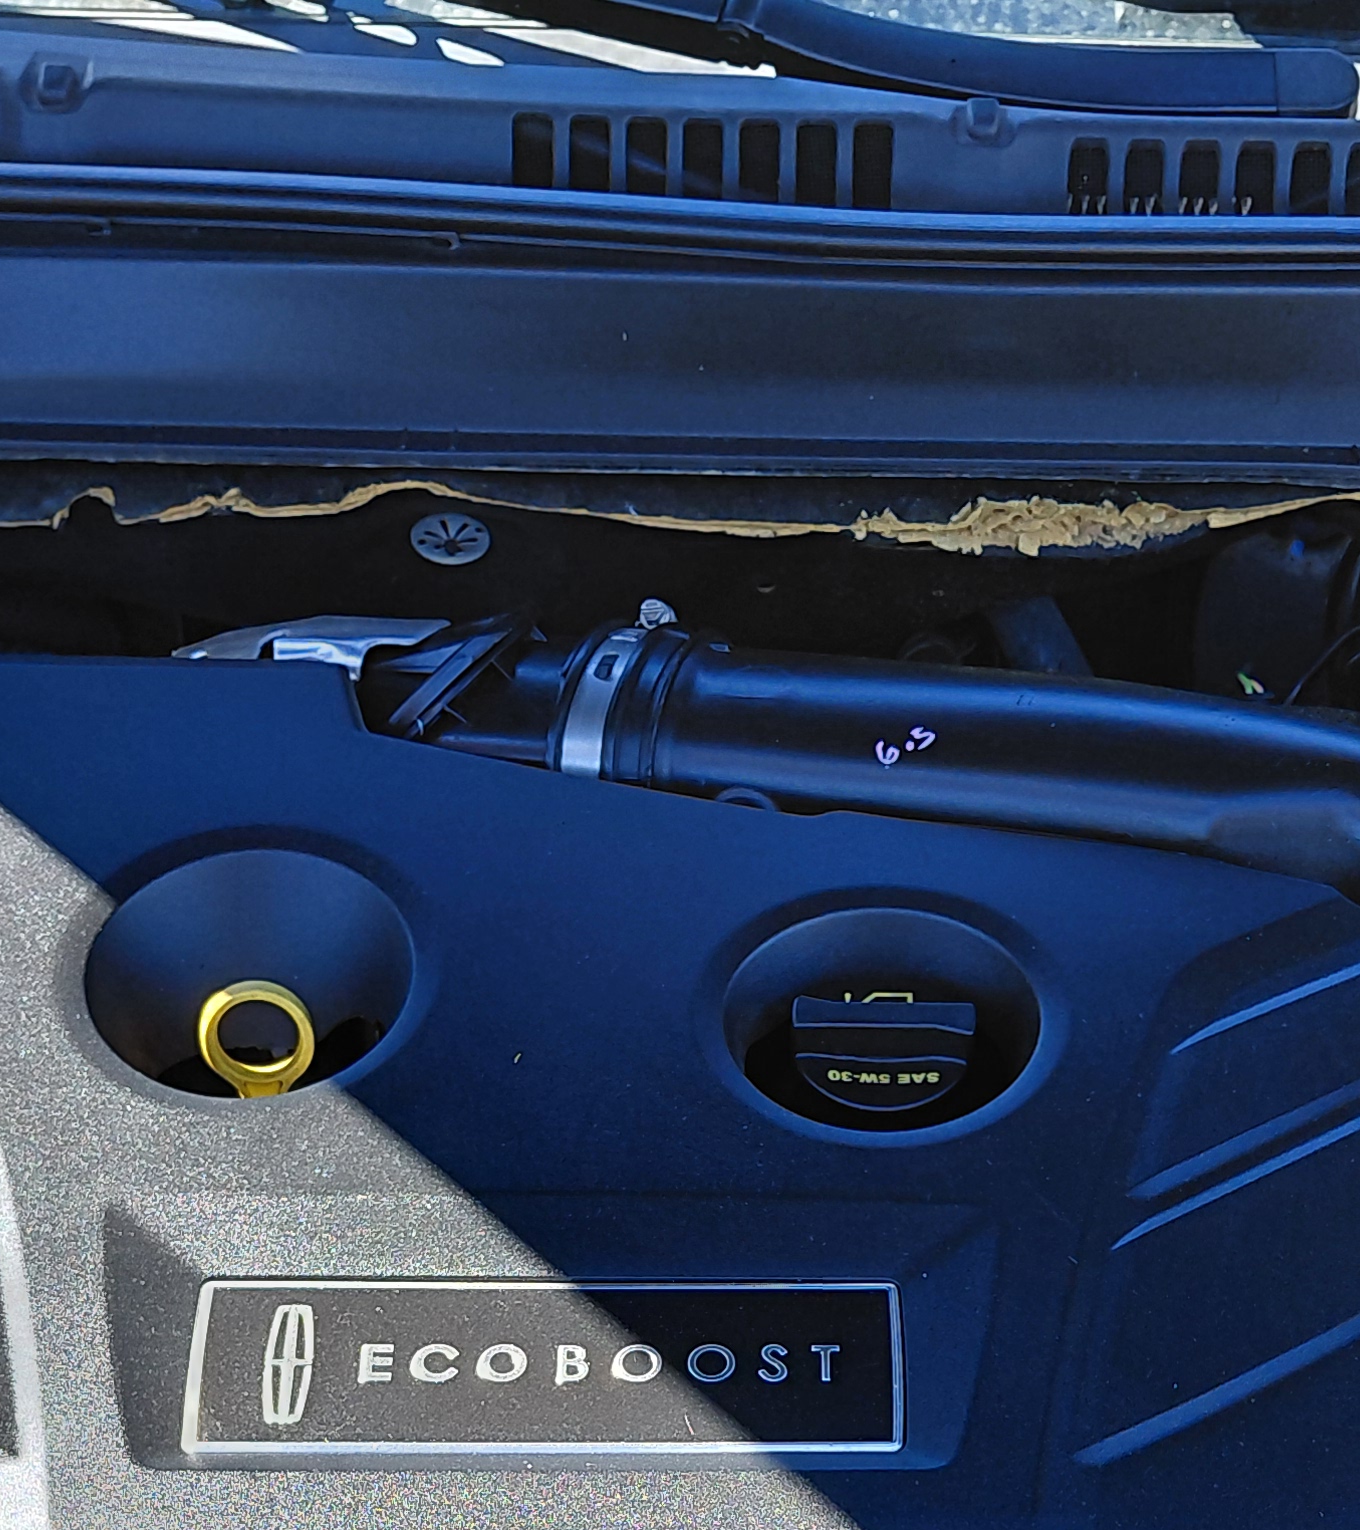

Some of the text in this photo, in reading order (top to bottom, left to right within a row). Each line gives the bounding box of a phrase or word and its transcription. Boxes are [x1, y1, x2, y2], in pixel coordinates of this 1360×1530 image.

[827, 1069, 940, 1084] SAE 5W-30
[357, 1343, 841, 1386] ECOBOOST
